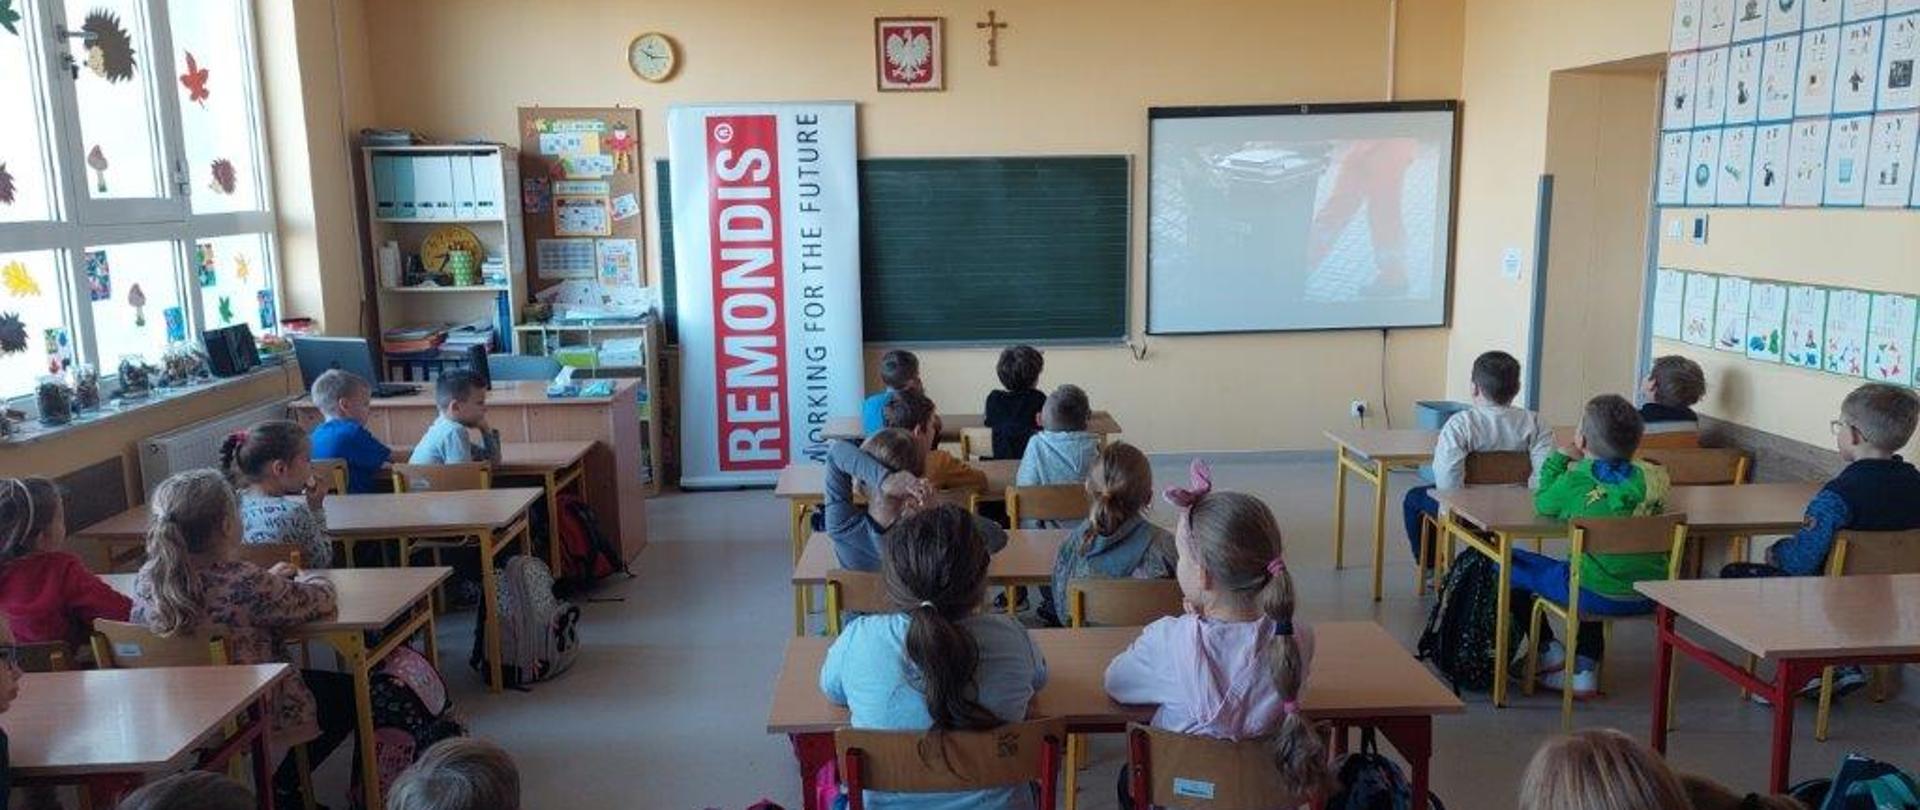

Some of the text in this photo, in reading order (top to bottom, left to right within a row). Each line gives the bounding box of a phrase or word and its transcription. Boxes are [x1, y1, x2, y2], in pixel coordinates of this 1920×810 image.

[796, 113, 821, 213] FUTURE
[801, 226, 823, 273] THE
[803, 285, 826, 333] FOR
